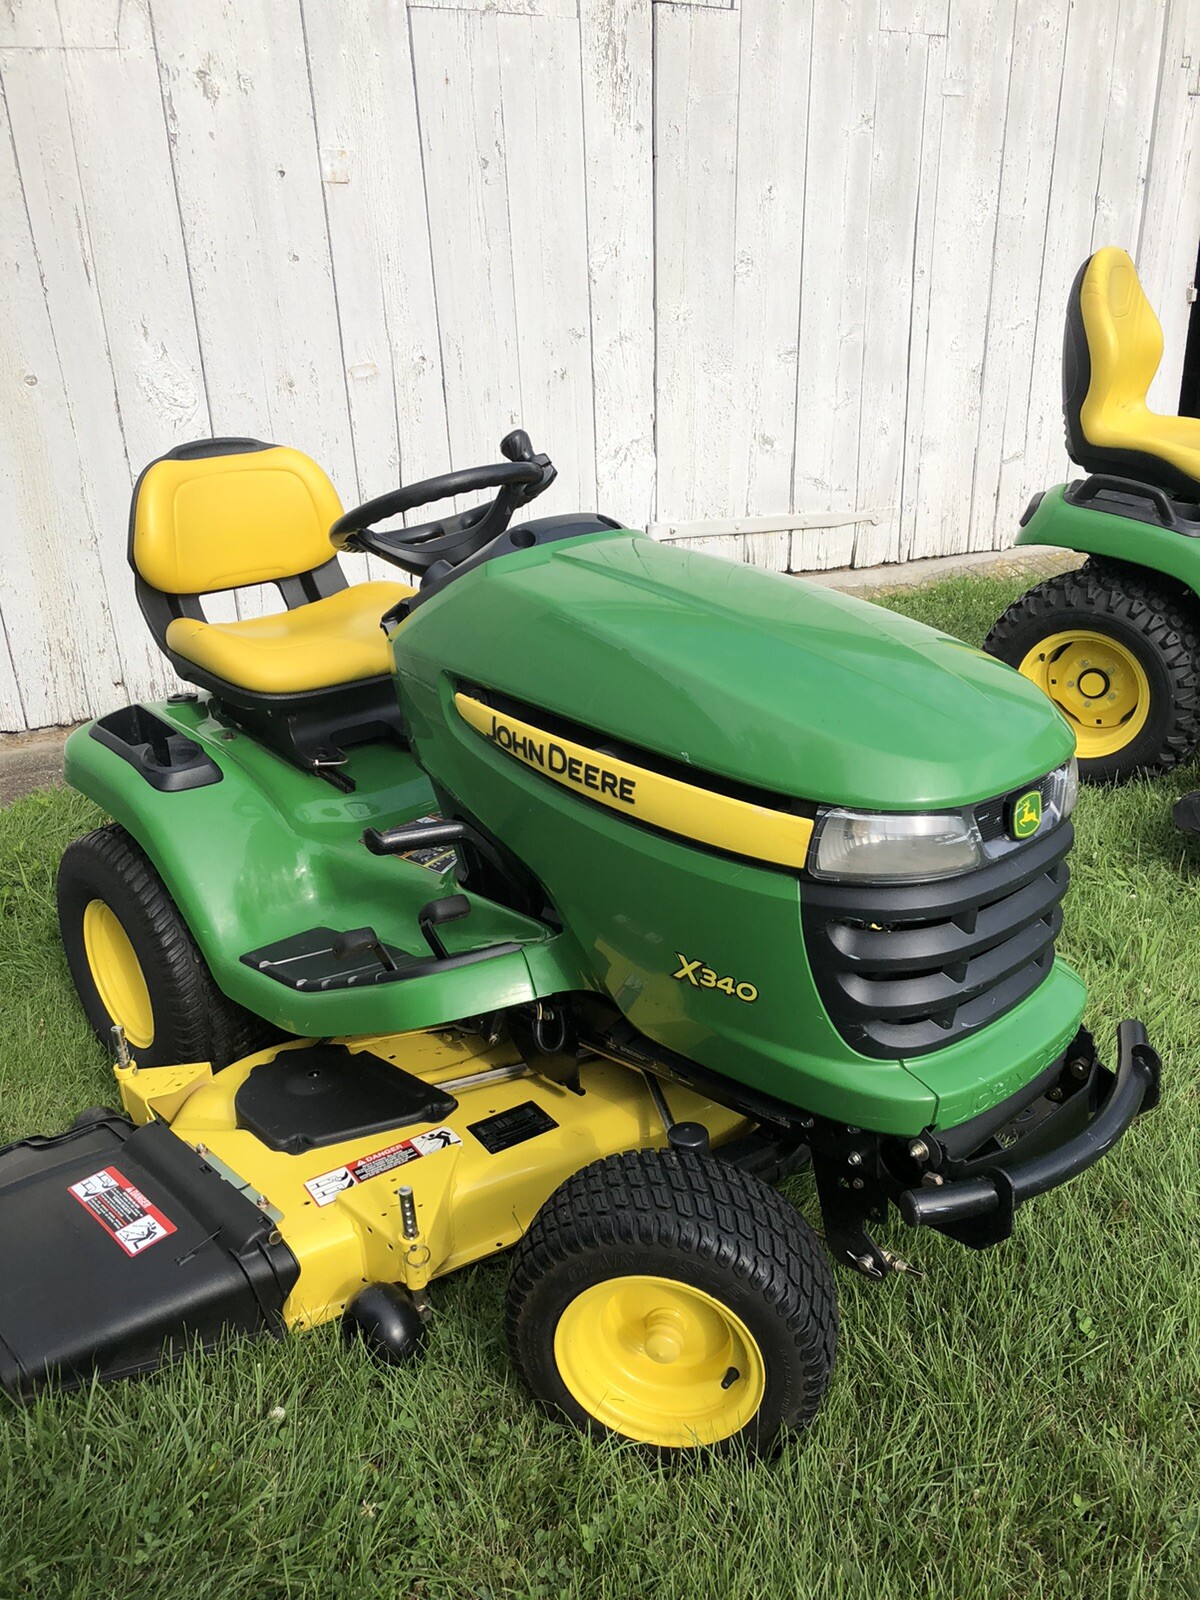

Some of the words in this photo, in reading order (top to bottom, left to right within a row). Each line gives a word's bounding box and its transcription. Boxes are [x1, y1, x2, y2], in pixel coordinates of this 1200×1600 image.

[486, 716, 544, 767] JOHN
[548, 743, 636, 804] DEERE
[670, 951, 759, 1003] X340
[365, 1144, 404, 1163] DANGER
